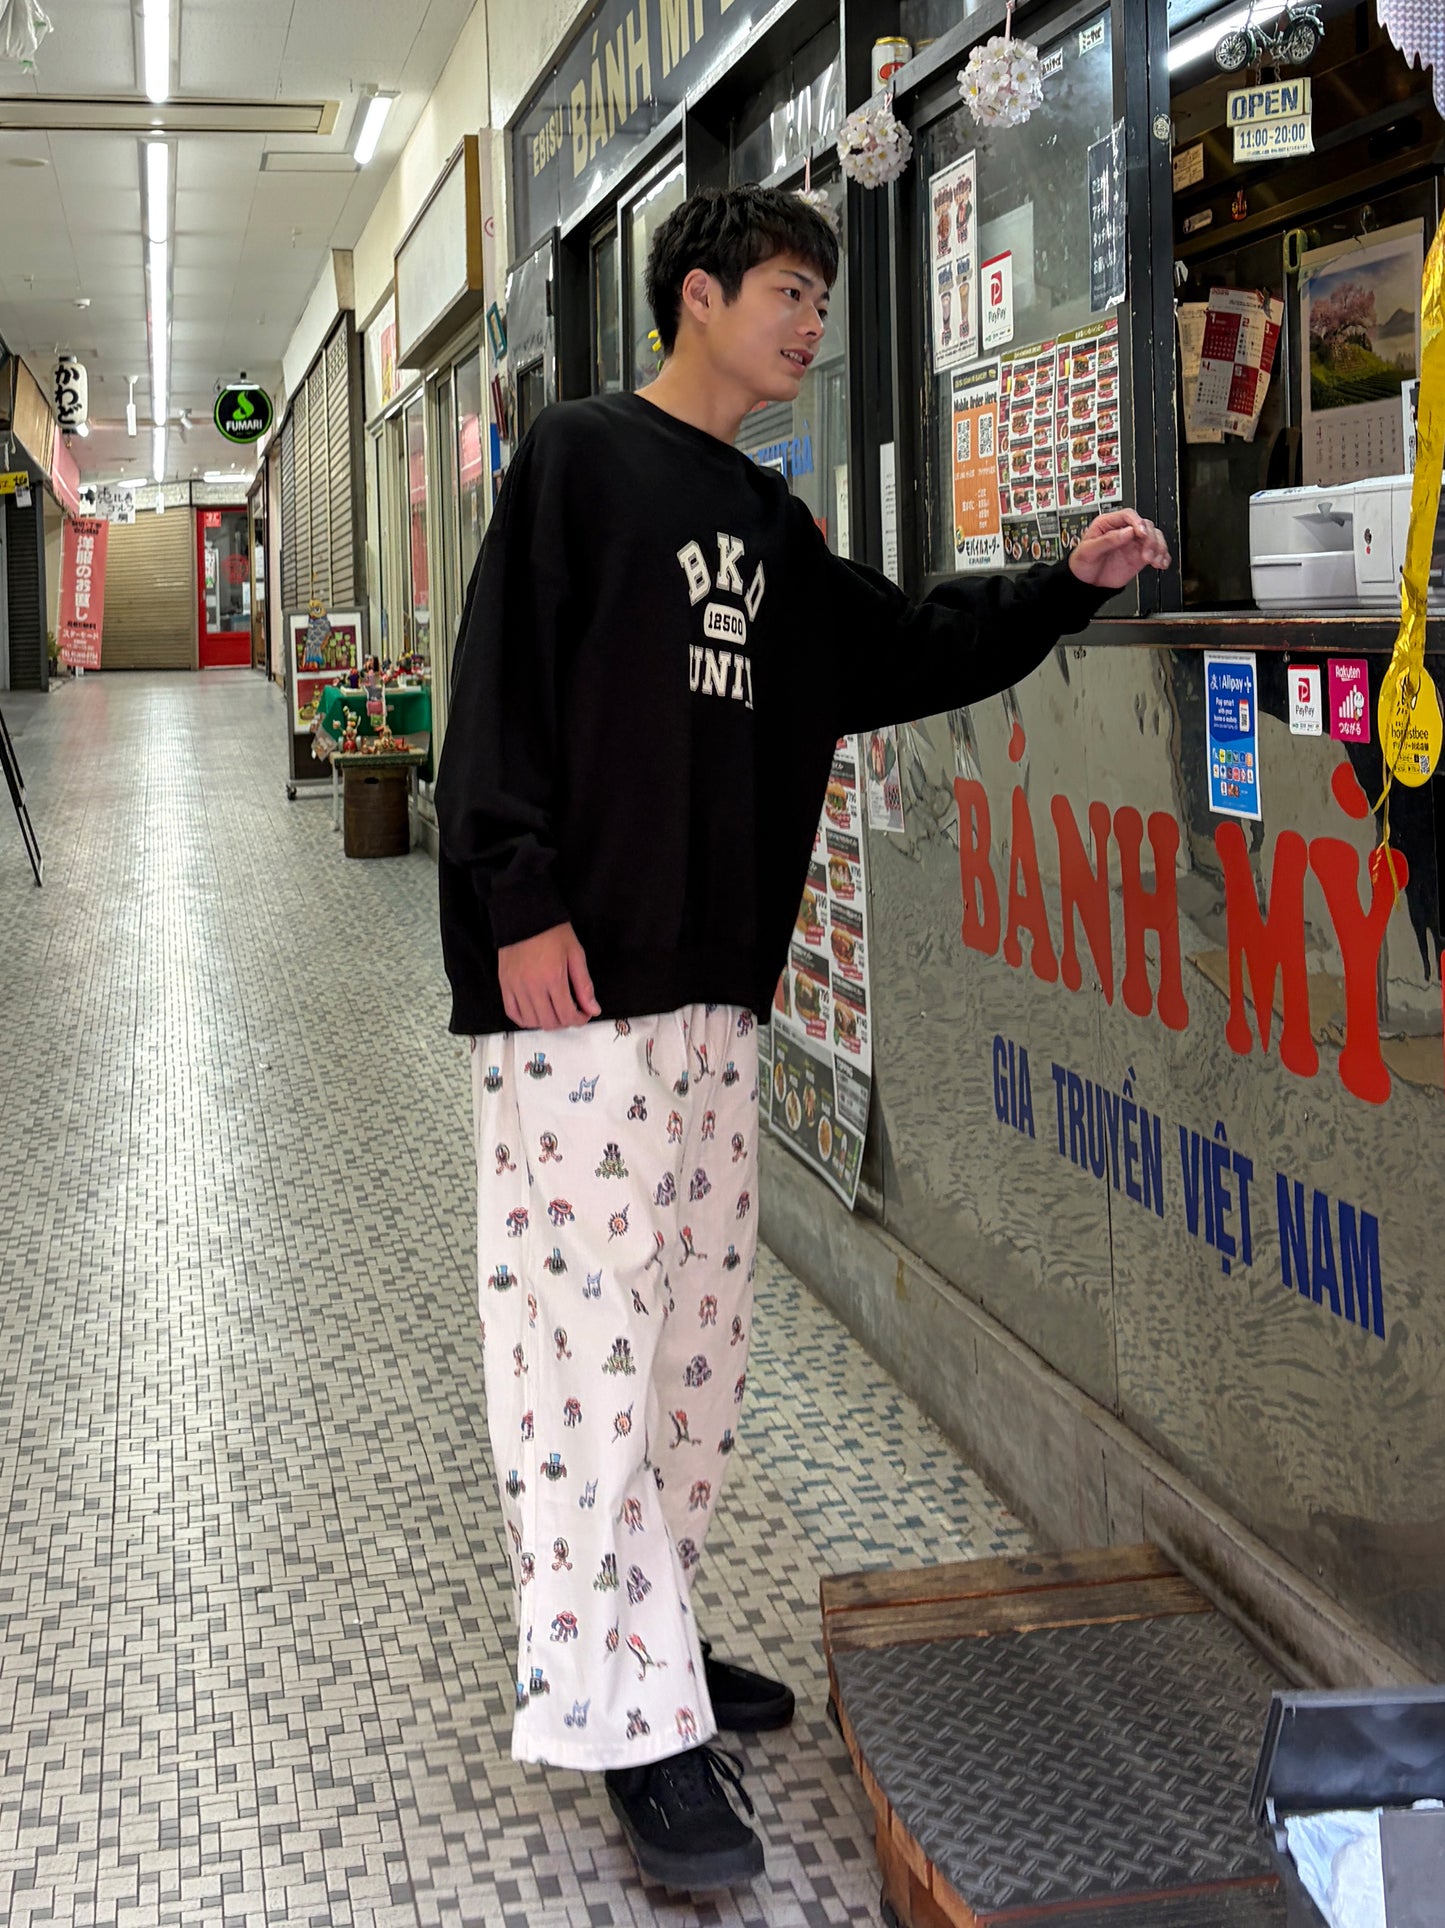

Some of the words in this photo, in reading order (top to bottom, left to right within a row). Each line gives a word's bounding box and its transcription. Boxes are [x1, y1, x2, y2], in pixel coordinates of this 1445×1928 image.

[533, 105, 563, 177] EBISU
[571, 0, 652, 179] BÁNH
[1231, 85, 1299, 121] OPEN
[1240, 122, 1306, 149] 11:00-20:00
[988, 306, 1006, 324] PayPay
[54, 364, 82, 425] かわど
[226, 419, 262, 432] FUMARI
[75, 535, 94, 622] 洋服のお直し
[708, 610, 743, 636] 12500
[1335, 665, 1360, 679] Rakuten
[1295, 704, 1315, 717] PayPay
[1338, 722, 1361, 735] つながる
[1391, 724, 1429, 739] honstbee
[993, 1034, 1036, 1140] GIA
[1051, 1065, 1165, 1220] TRUYỀN
[1179, 1120, 1254, 1277] VIỆT
[1276, 1171, 1386, 1342] NAM
